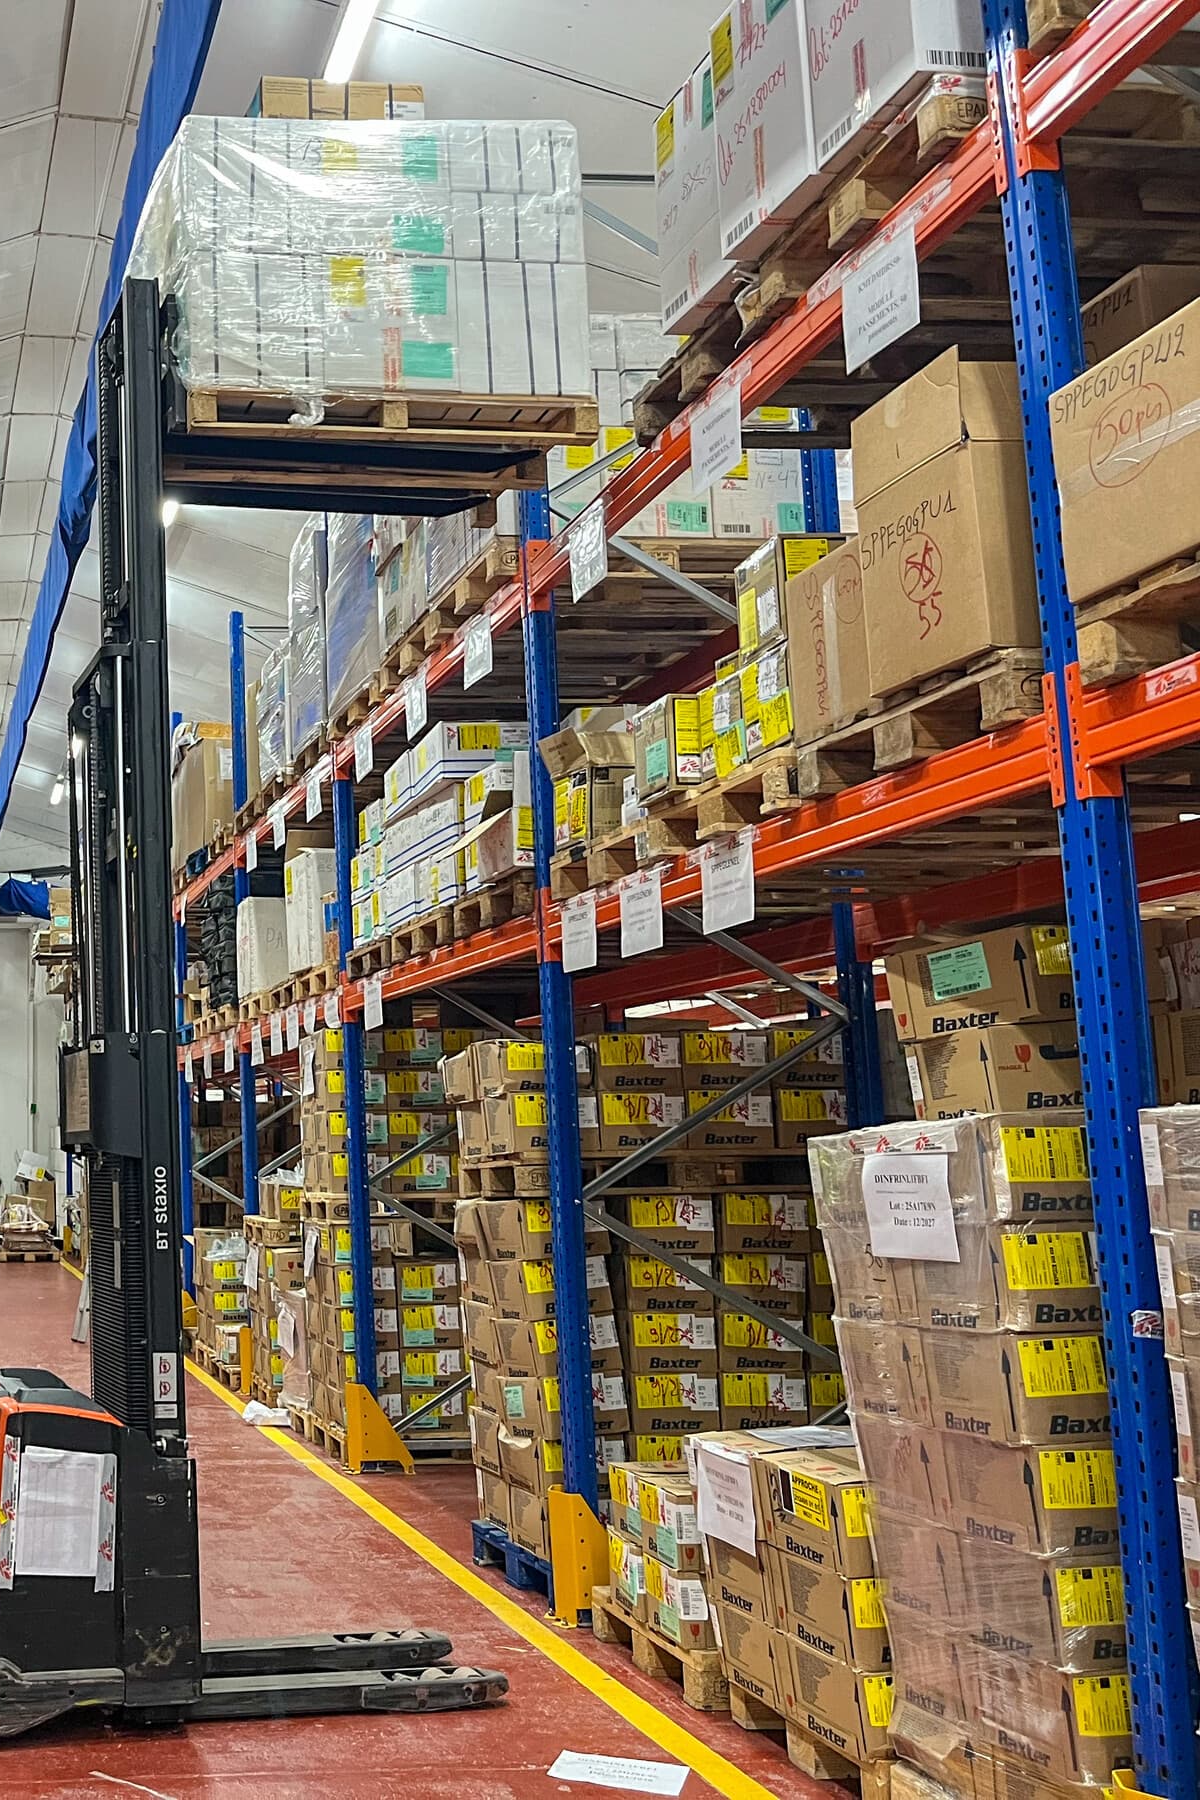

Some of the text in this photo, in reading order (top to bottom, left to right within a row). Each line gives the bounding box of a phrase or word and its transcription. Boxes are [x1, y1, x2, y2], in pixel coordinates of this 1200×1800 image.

[933, 1010, 1000, 1034] Baxter
[520, 1080, 546, 1090] Bax
[615, 1075, 666, 1087] Baxter
[701, 1073, 747, 1085] Baxt
[786, 1071, 839, 1083] Baxter
[1027, 1091, 1085, 1109] Baxt
[618, 1135, 651, 1146] Bax
[705, 1133, 759, 1145] Baxter
[889, 1201, 901, 1211] Lot
[1022, 1192, 1094, 1212] Baxt
[894, 1216, 908, 1227] Date
[156, 1229, 169, 1250] BT
[741, 1237, 794, 1249] Baxter
[647, 1298, 698, 1311] Baxter
[749, 1297, 791, 1310] axter
[931, 1308, 980, 1330] Baxter
[1035, 1303, 1103, 1324] Baxt
[650, 1357, 702, 1370] Baxter
[736, 1356, 788, 1370] Baxter
[513, 1425, 535, 1438] Baxter
[651, 1418, 704, 1430] Baxter
[740, 1417, 793, 1430] Baxter
[944, 1411, 992, 1437] Baxter
[1049, 1415, 1111, 1436] Baxt
[966, 1516, 1016, 1546] Baxter
[1073, 1525, 1120, 1547] Bax
[786, 1535, 826, 1565] Baxter
[721, 1586, 754, 1613] Baxter
[797, 1622, 837, 1656] Baxter
[733, 1668, 765, 1699] Baxter
[904, 1682, 947, 1717] Baxter
[807, 1713, 848, 1751] Baxter
[998, 1729, 1051, 1768] Baxter
